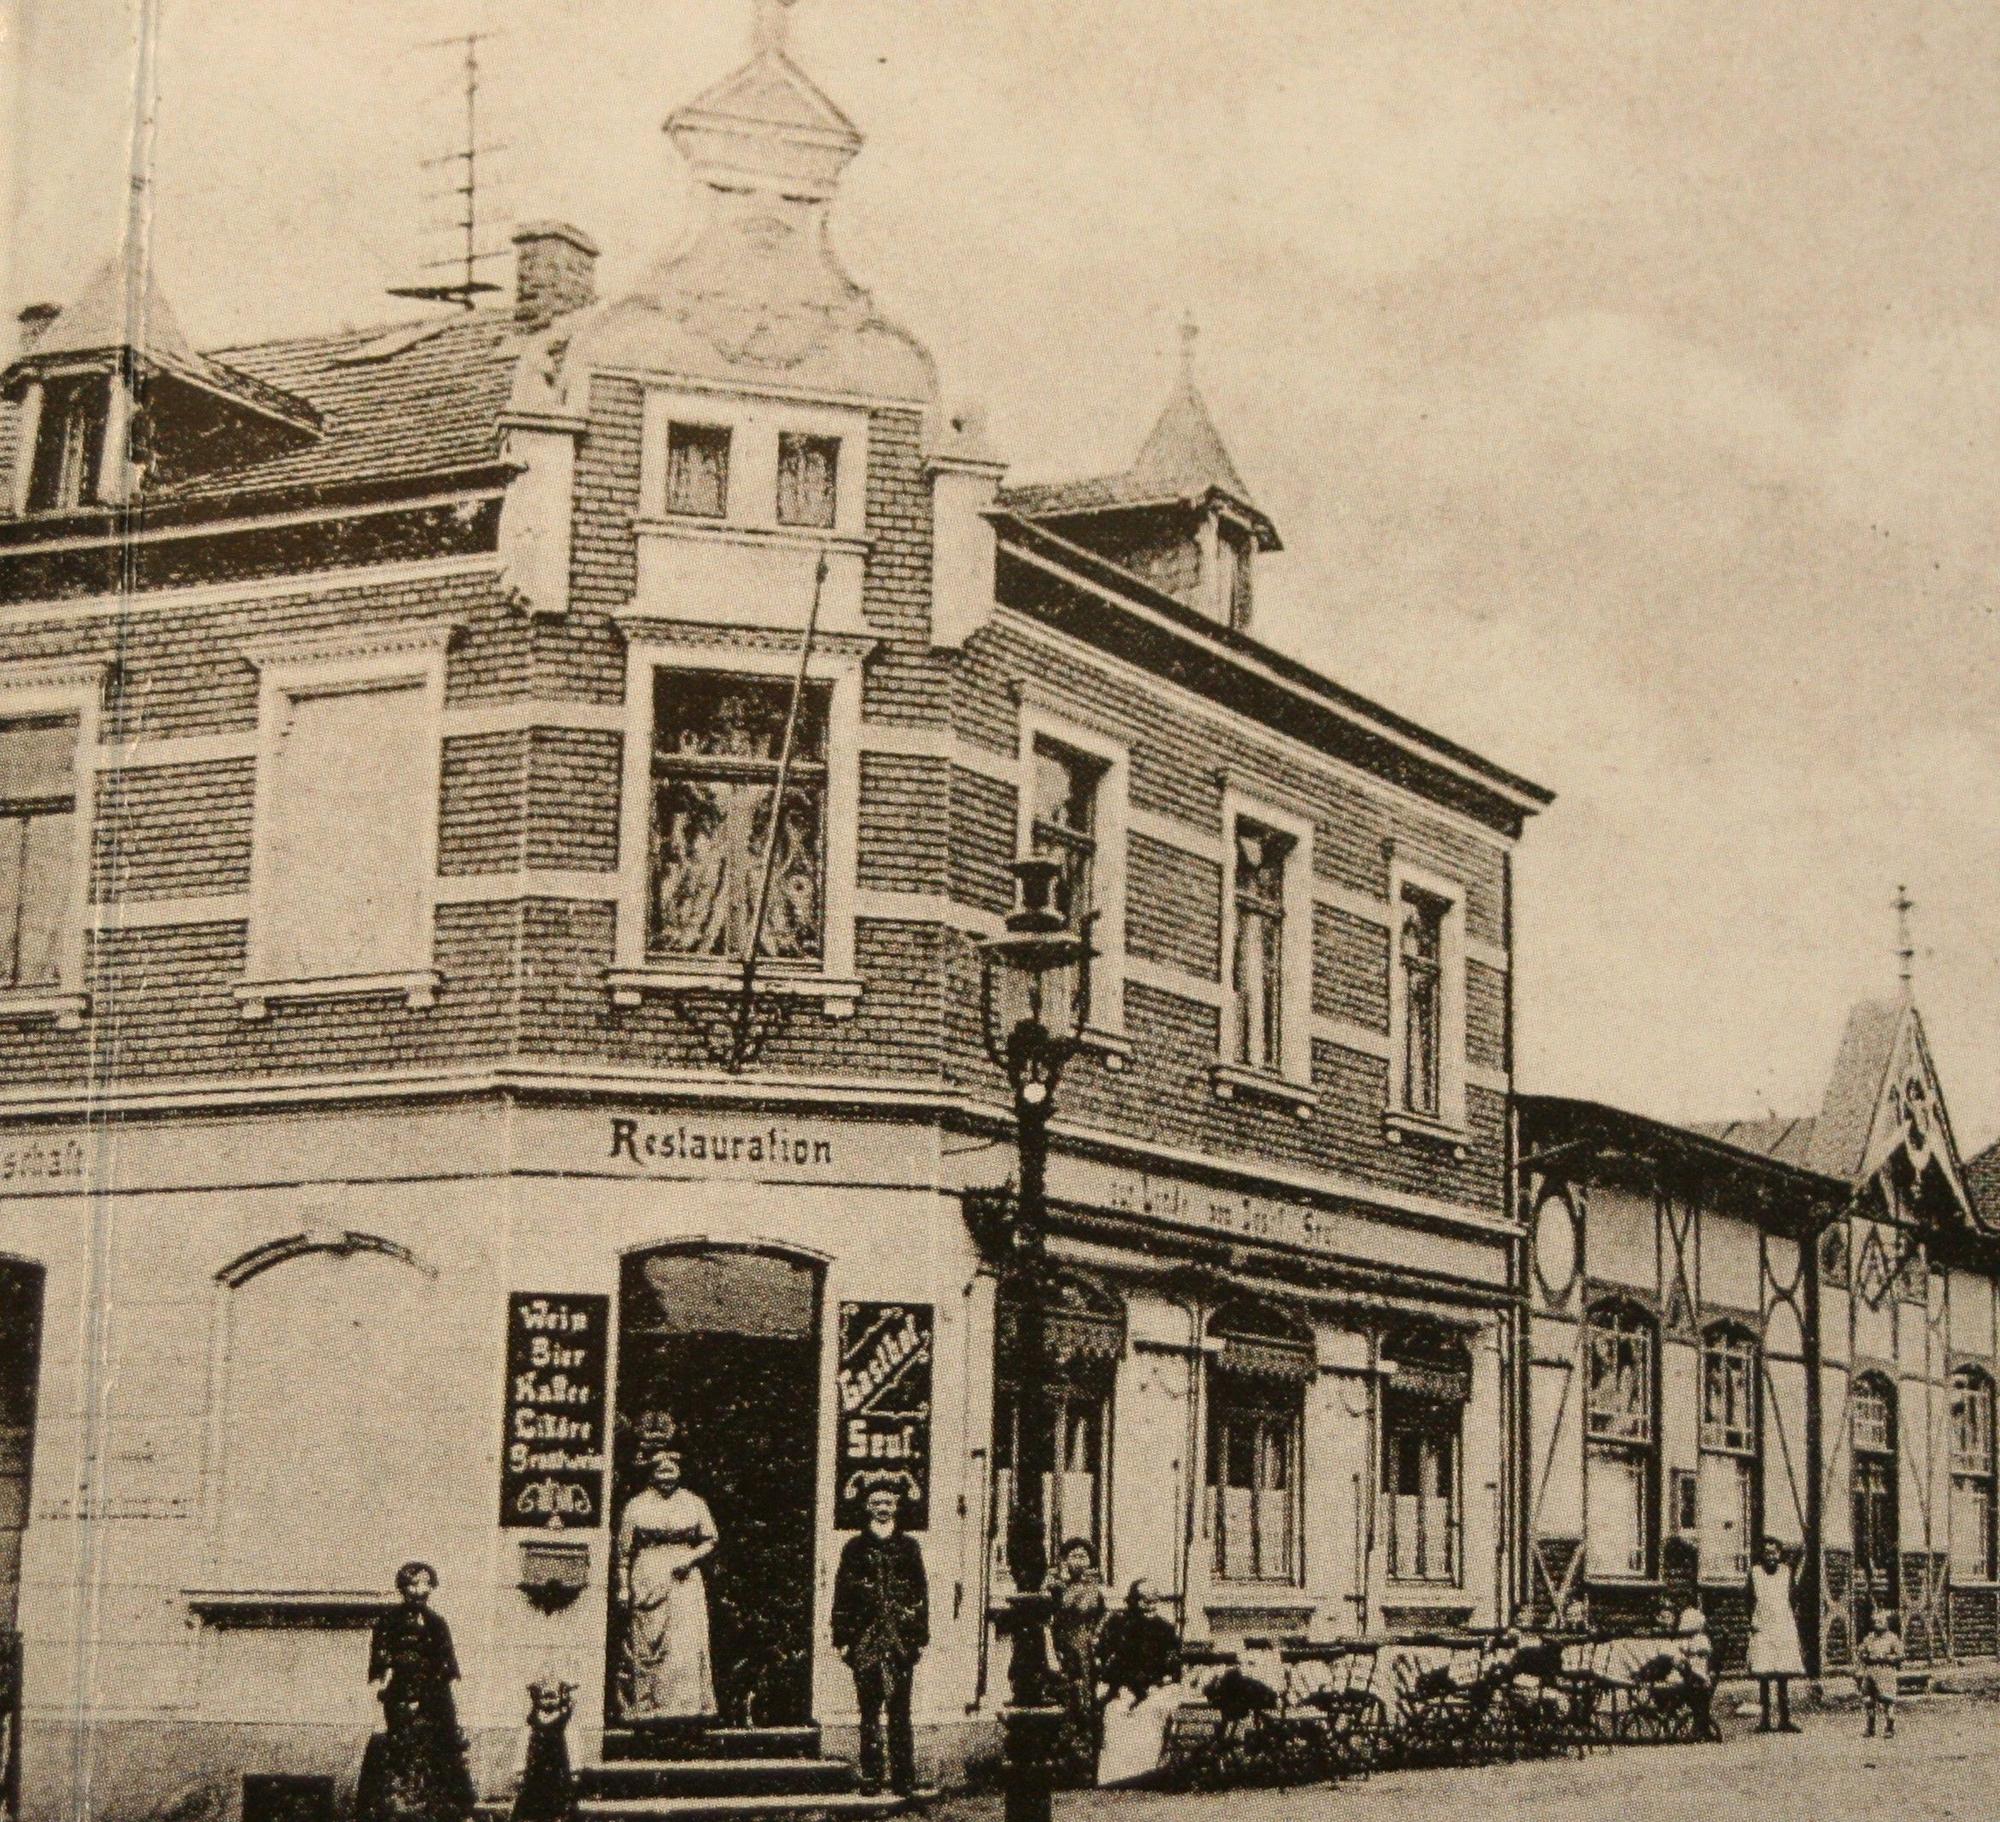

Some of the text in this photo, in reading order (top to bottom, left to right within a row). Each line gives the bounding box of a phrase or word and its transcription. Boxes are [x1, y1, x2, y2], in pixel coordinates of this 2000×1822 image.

[609, 1118, 832, 1165] Restauration
[519, 1299, 589, 1332] Wein
[530, 1336, 586, 1367] Bier
